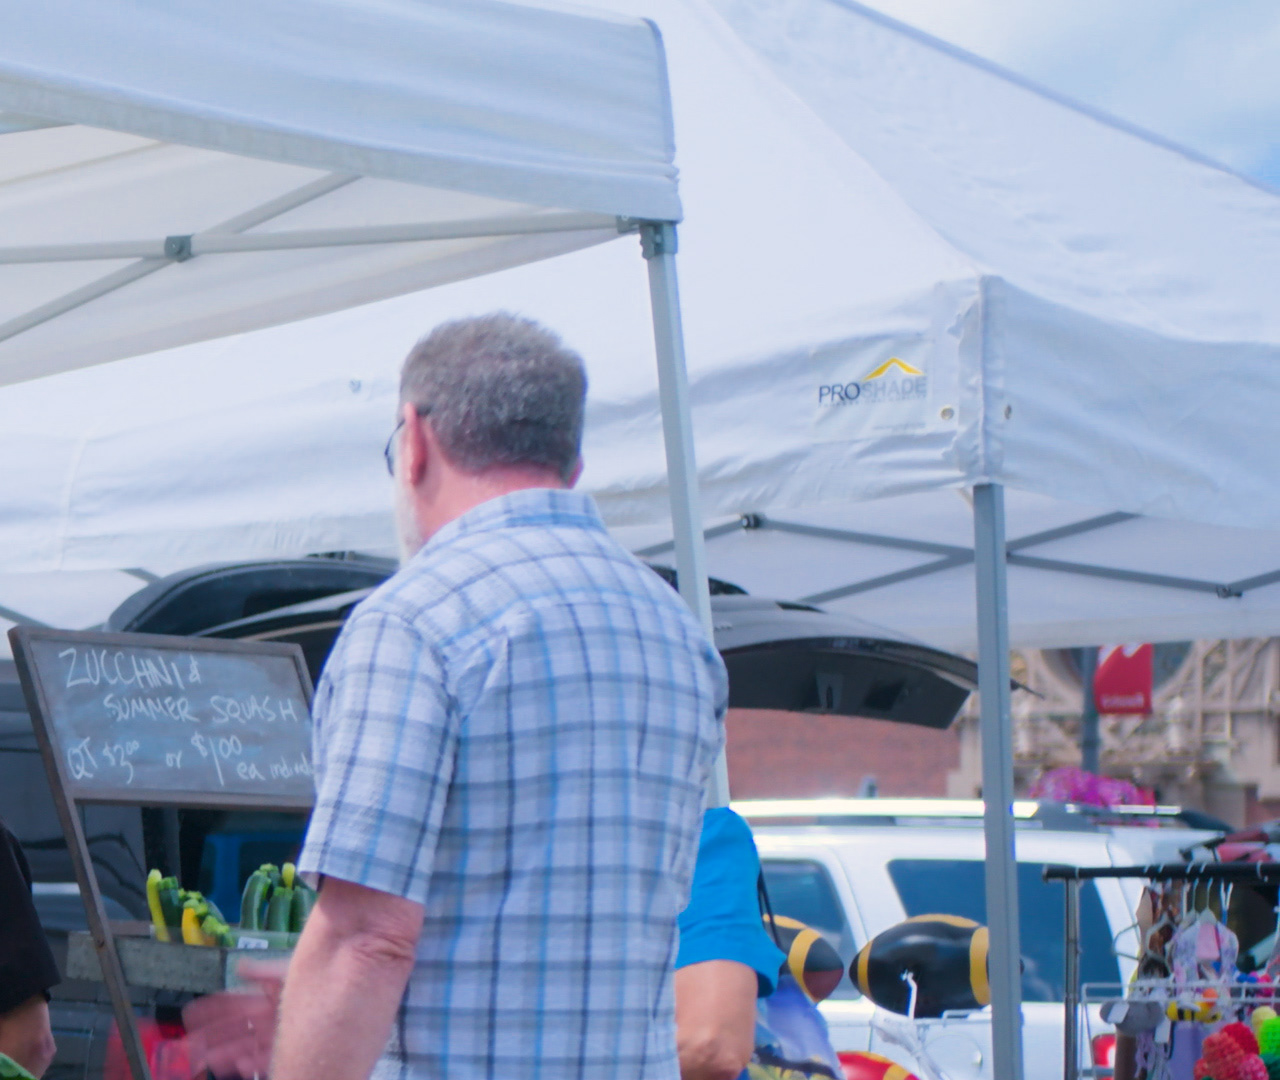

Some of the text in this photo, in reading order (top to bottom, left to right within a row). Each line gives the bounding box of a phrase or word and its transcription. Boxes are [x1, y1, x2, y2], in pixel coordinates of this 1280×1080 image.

[819, 376, 927, 403] PROSHADE
[58, 647, 185, 690] ZUCCHINI
[103, 693, 298, 724] SUMMER SQUASH
[236, 761, 266, 781] ea
